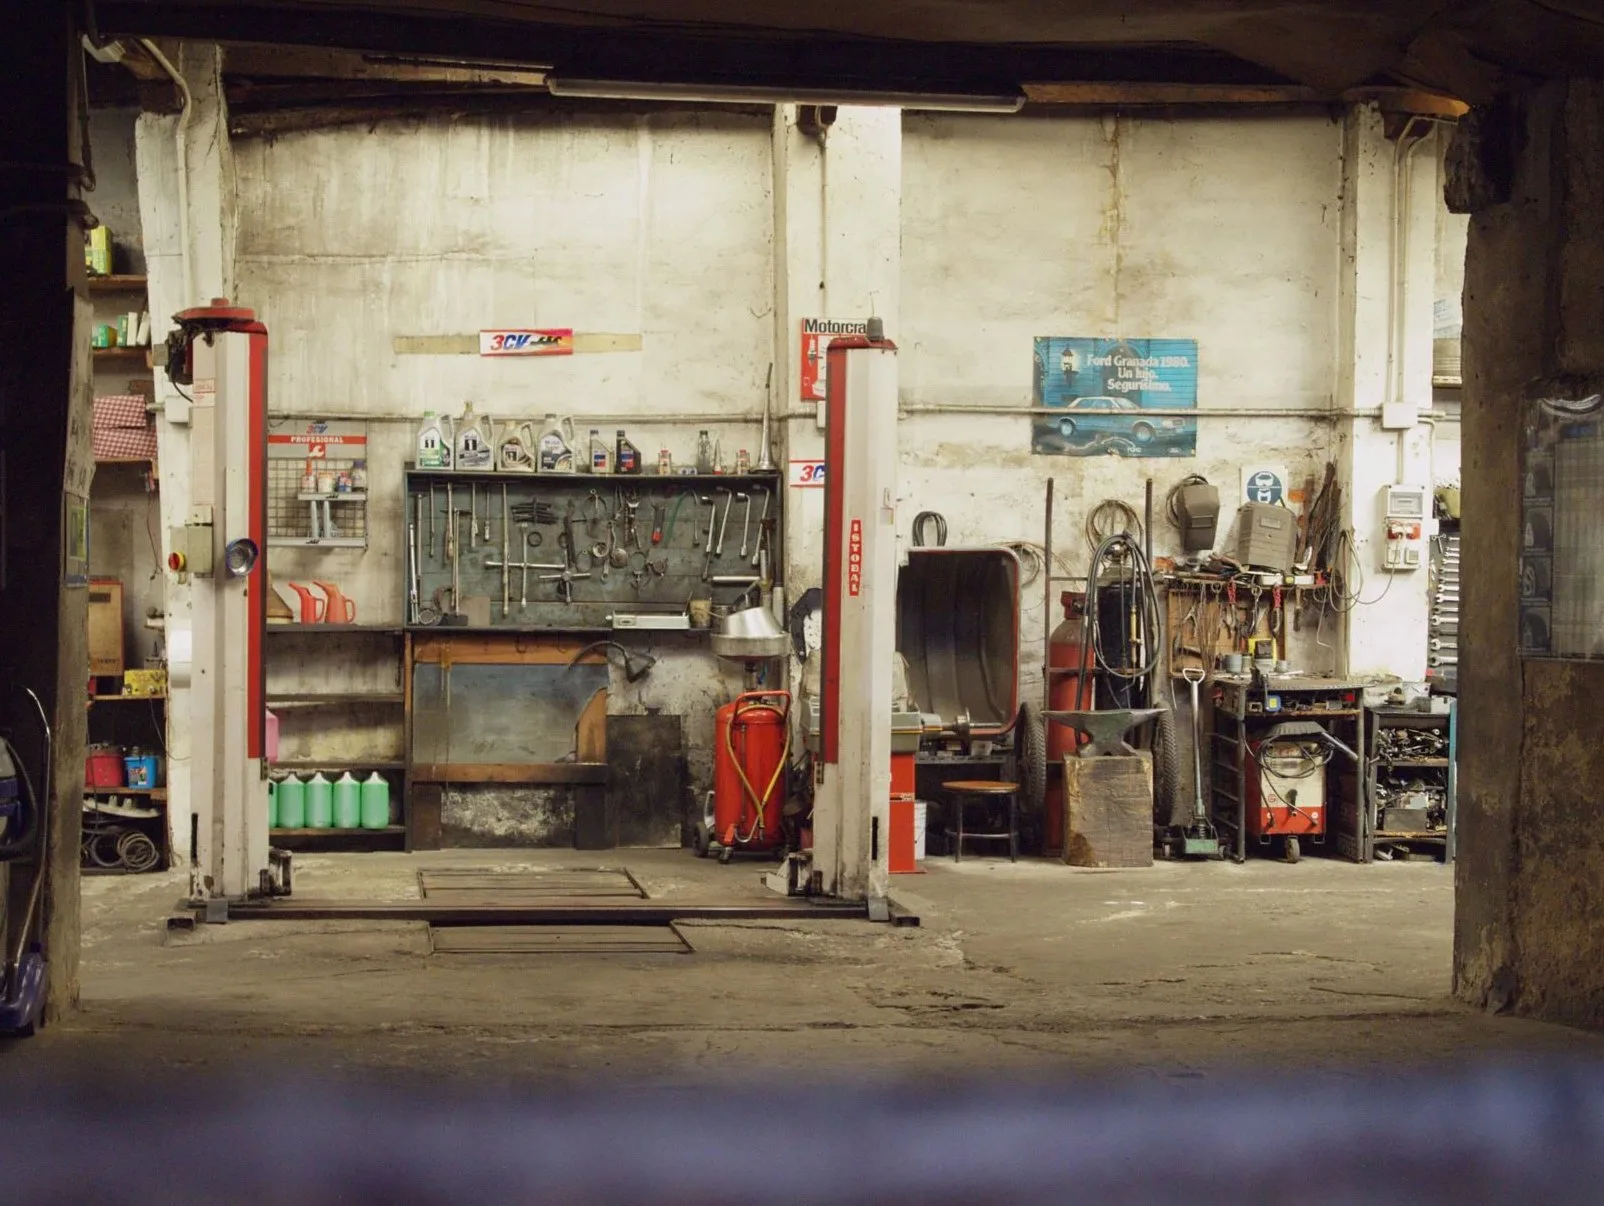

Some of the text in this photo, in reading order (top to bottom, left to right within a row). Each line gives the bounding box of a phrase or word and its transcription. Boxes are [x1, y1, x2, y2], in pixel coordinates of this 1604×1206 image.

[804, 318, 867, 334] Motorcra
[491, 334, 532, 351] 3CV
[1087, 354, 1112, 367] Ford
[1114, 354, 1159, 367] Granada
[1118, 367, 1132, 379] Un
[800, 464, 825, 482] 3C
[850, 523, 860, 592] ISTOBAL
